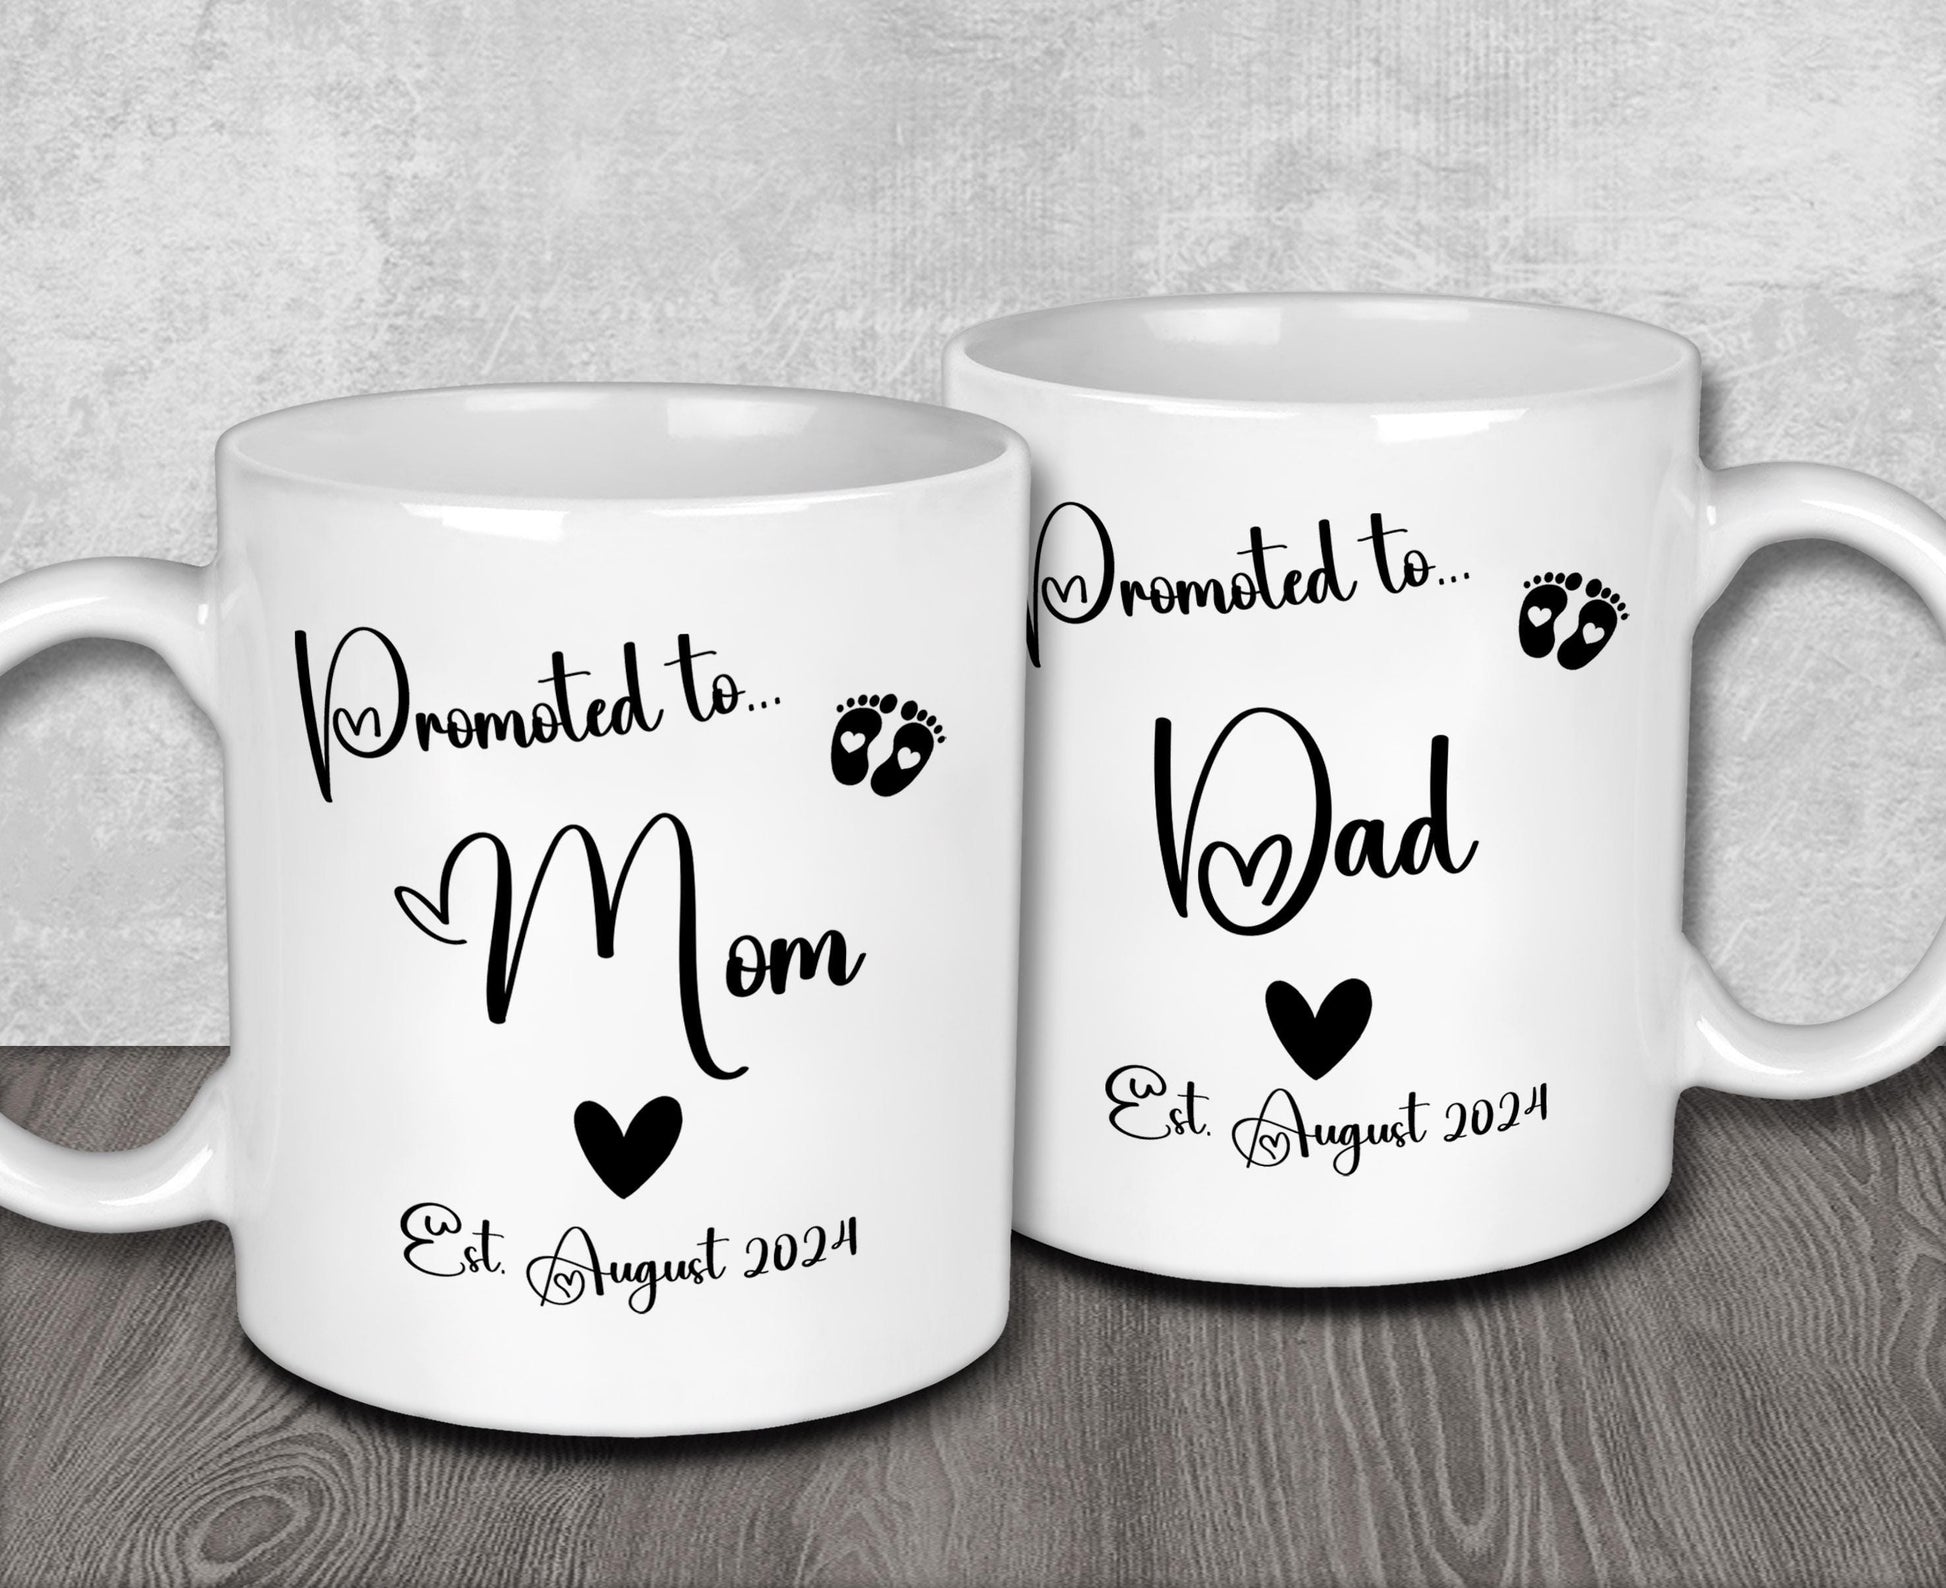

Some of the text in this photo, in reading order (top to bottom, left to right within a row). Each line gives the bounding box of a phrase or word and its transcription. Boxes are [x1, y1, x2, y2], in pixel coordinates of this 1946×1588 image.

[1026, 501, 1357, 668] Promoted
[294, 626, 781, 803] Promoted to...
[1153, 707, 1480, 937] Dad
[393, 812, 867, 1081] Mom
[1104, 1064, 1548, 1177] Est. August 2024
[400, 1202, 857, 1315] Est. August 2024
